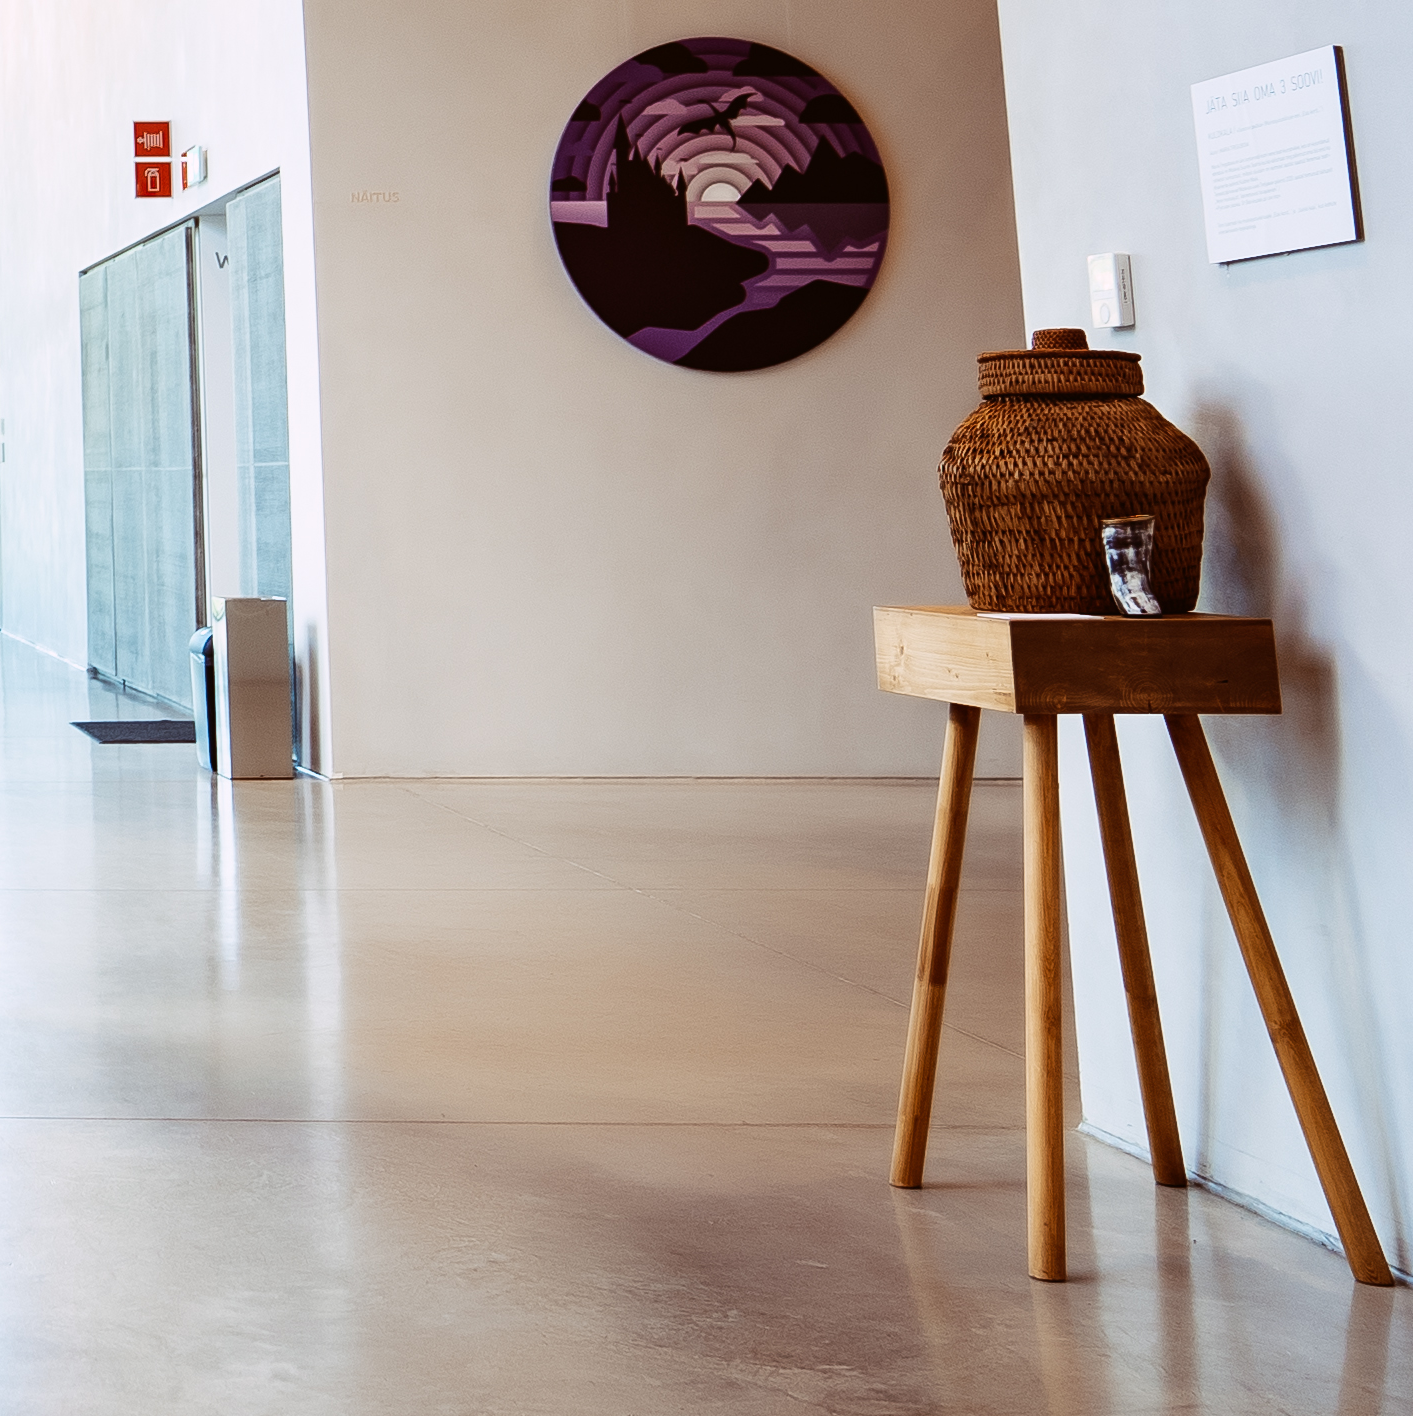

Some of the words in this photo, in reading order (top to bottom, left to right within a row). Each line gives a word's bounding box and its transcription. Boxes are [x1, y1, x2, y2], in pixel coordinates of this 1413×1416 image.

[1206, 95, 1228, 114] JÄTA
[1231, 90, 1250, 107] SIIA
[1254, 83, 1276, 101] OMA
[1280, 79, 1286, 94] 3
[1291, 69, 1324, 92] SOOVI!
[351, 190, 400, 203] NÄITUS
